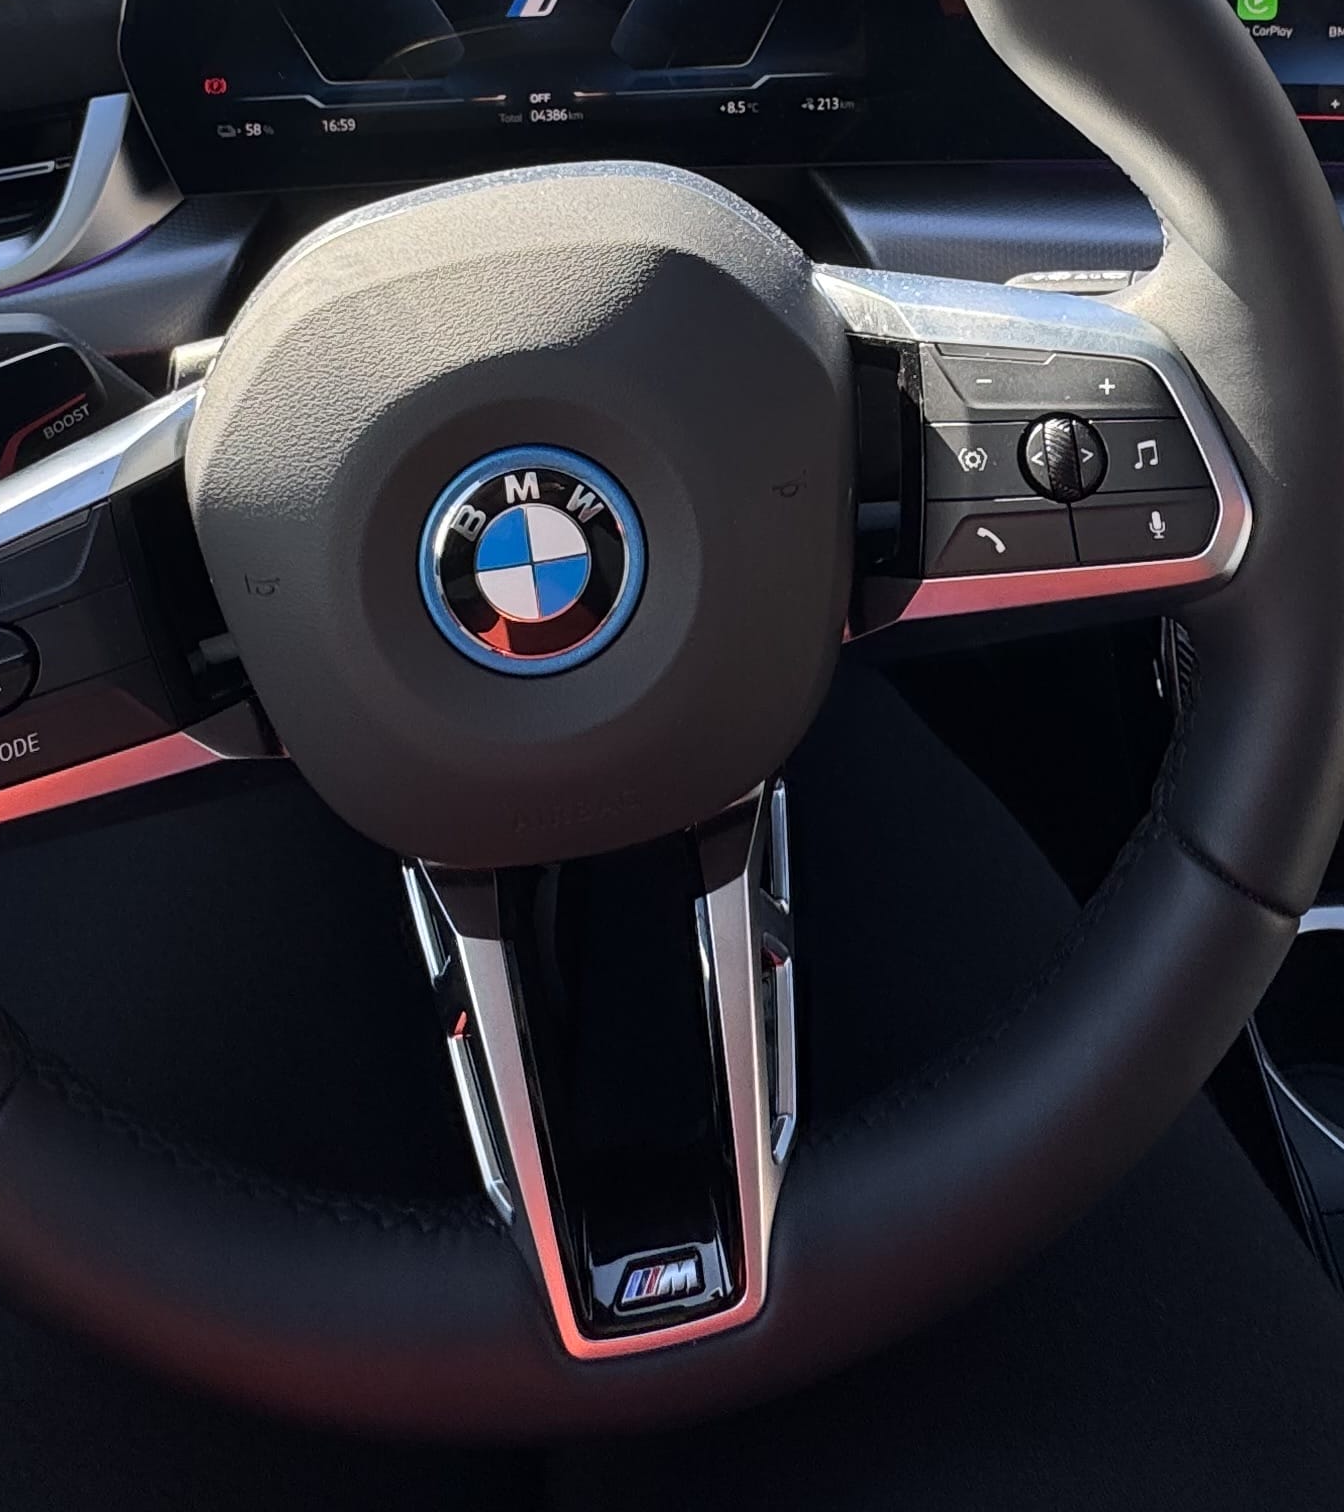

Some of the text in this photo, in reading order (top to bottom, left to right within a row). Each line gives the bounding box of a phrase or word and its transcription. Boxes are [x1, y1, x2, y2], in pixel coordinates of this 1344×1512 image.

[1252, 26, 1293, 39] CarPlay
[530, 92, 552, 104] OFF
[817, 97, 839, 111] 213
[499, 113, 523, 123] Total
[530, 109, 568, 122] 04386
[245, 122, 263, 137] 58
[321, 118, 356, 133] 16:59
[43, 402, 92, 441] BOOST
[450, 471, 605, 542] BMW
